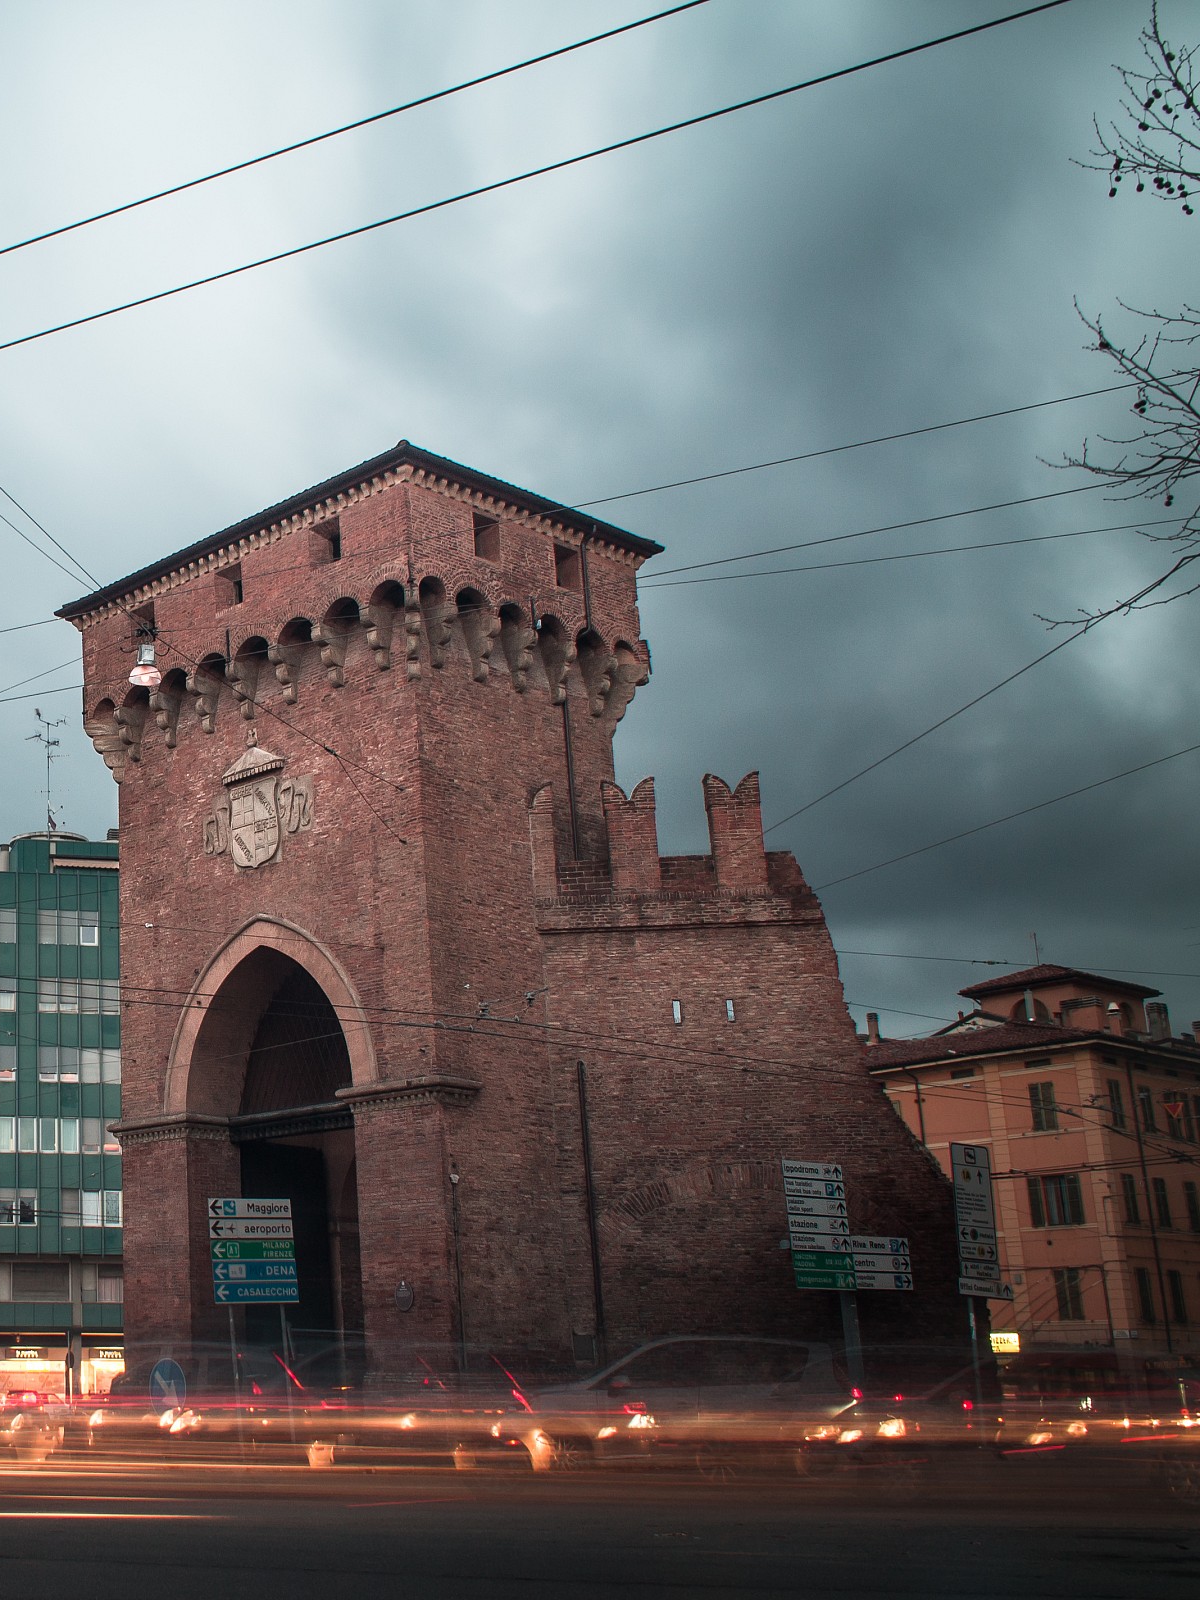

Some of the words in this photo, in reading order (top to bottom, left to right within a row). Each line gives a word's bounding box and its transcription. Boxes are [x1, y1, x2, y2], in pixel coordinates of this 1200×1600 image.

[784, 1164, 818, 1174] ippodromo
[247, 1203, 289, 1214] Maggiore
[790, 1220, 818, 1228] stazione
[244, 1224, 290, 1236] aeroporto
[237, 1287, 297, 1296] CASALECCHIO
